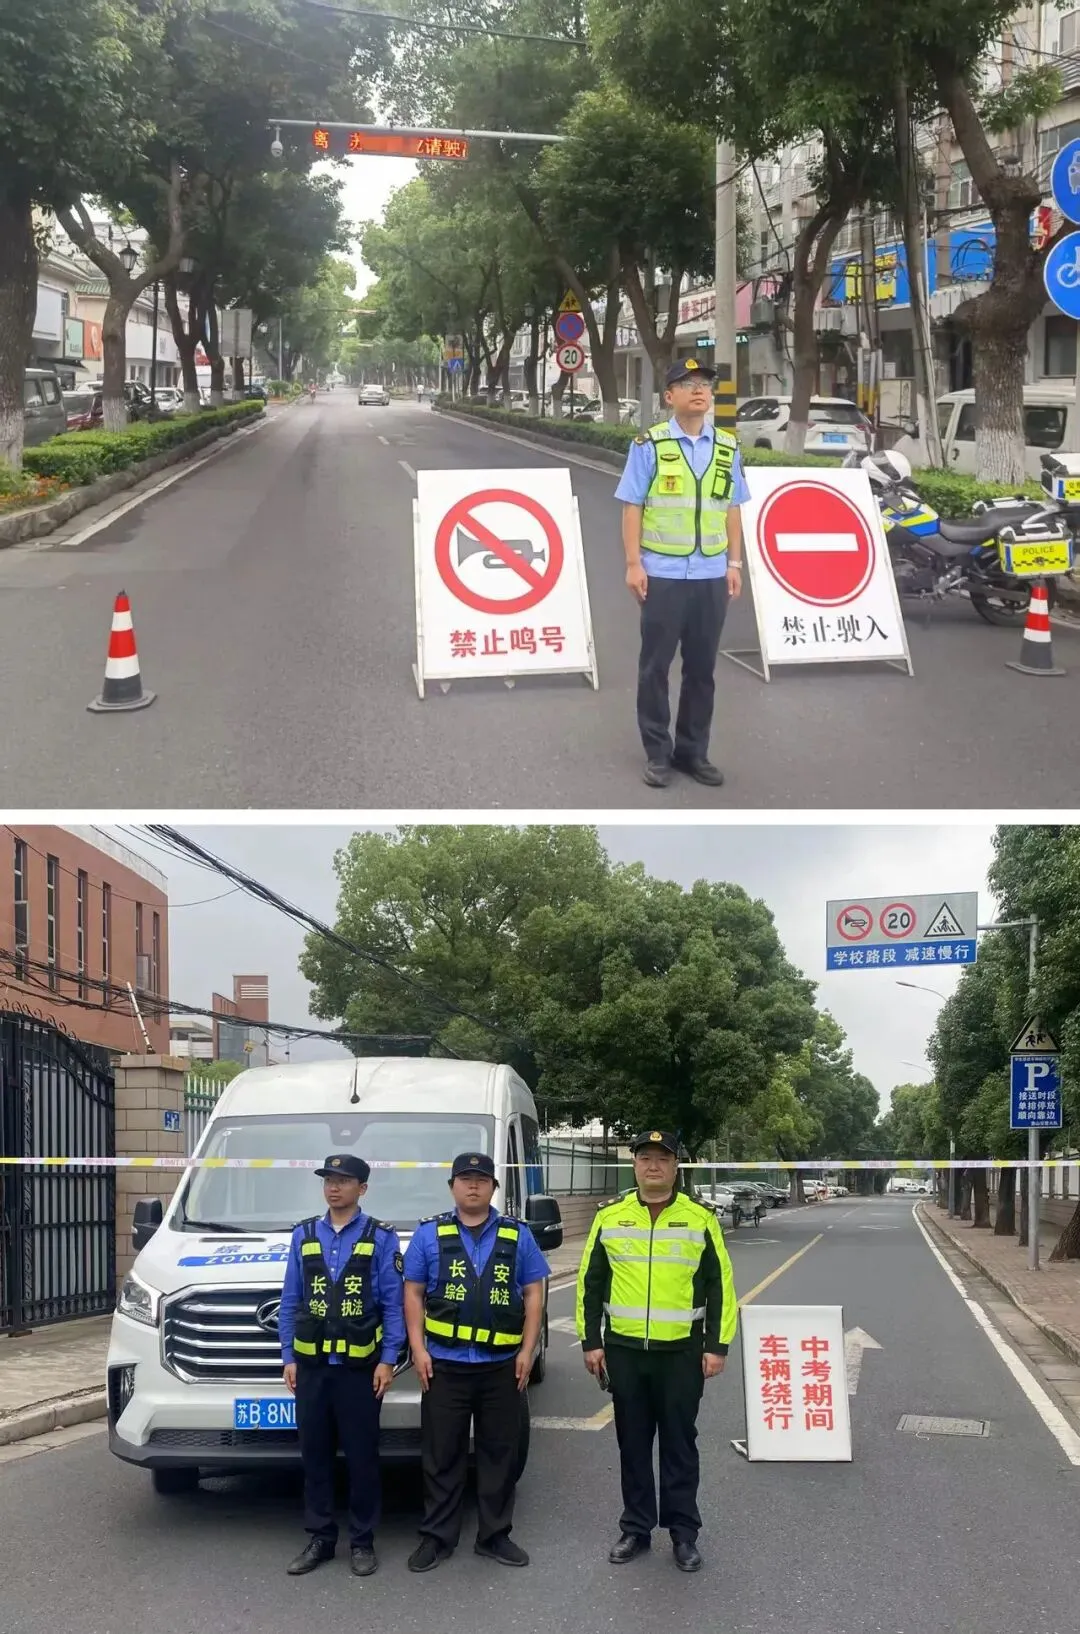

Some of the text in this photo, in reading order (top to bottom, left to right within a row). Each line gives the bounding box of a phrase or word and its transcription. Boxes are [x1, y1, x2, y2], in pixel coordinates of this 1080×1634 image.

[564, 349, 578, 365] 20
[1022, 546, 1055, 556] POLICE
[782, 615, 888, 645] 禁止驶入
[450, 626, 565, 658] 禁止鸣号
[887, 912, 910, 930] 20
[833, 945, 970, 965] 学校路段 减速慢行
[1024, 1062, 1050, 1091] P
[1018, 1101, 1056, 1110] 单排停放
[1019, 1091, 1056, 1100] 接送时段
[1017, 1111, 1056, 1120] 顺向靠边
[205, 1254, 272, 1265] ZONG
[449, 1259, 511, 1283] 长 安
[311, 1275, 363, 1295] 长 安
[445, 1283, 511, 1305] 综合 执法
[309, 1298, 363, 1317] 综合 执法
[759, 1334, 793, 1430] 车辆绕行
[800, 1336, 834, 1431] 中考期间
[236, 1402, 296, 1424] 苏B·8N
